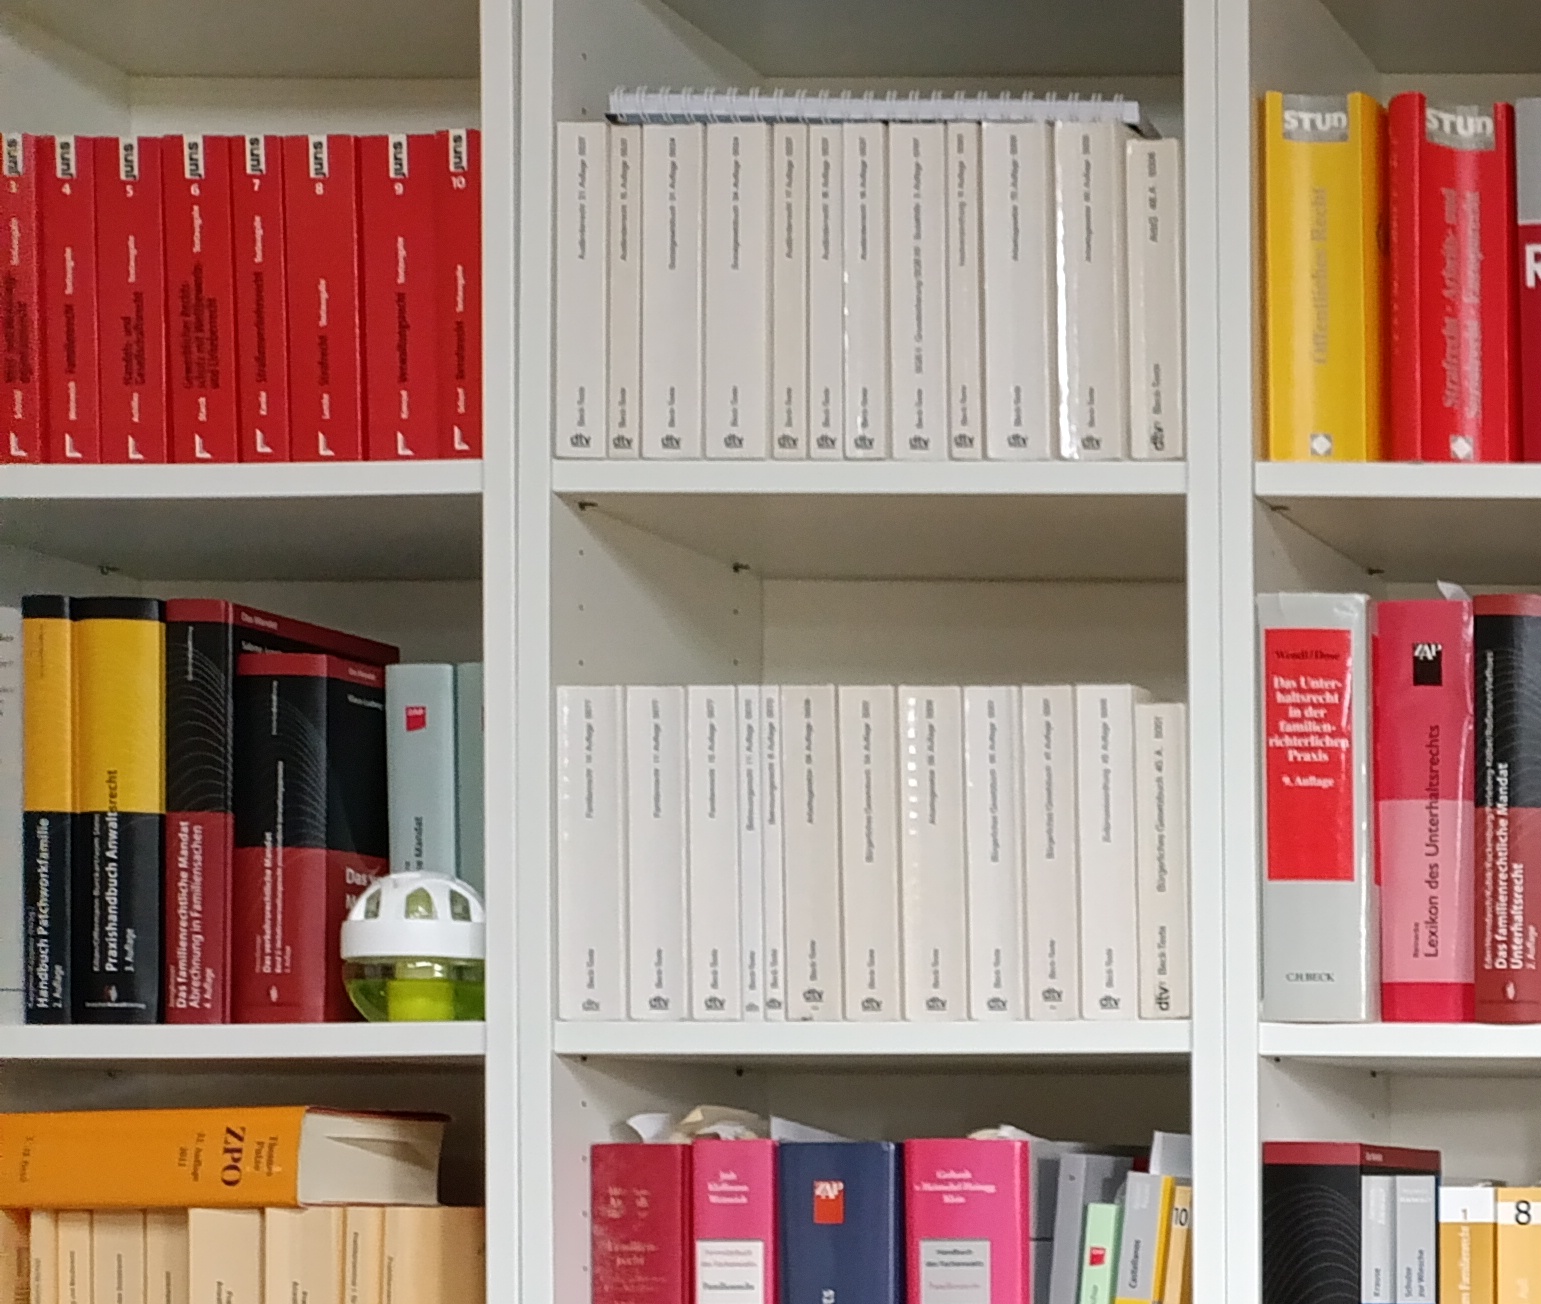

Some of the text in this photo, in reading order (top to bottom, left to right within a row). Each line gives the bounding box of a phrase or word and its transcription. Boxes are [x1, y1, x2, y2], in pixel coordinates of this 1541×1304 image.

[37, 818, 51, 1008] Handbuch Patchworkfamilie
[106, 770, 119, 971] Praxishandbuch Anwaltsrecht
[1426, 725, 1441, 957] Lexikon des Unterhaltsrechts
[1495, 763, 1509, 969] Das familienrechtliche Mandat
[1510, 863, 1524, 969] Unterhaltsrecht
[220, 1126, 246, 1187] ZPO
